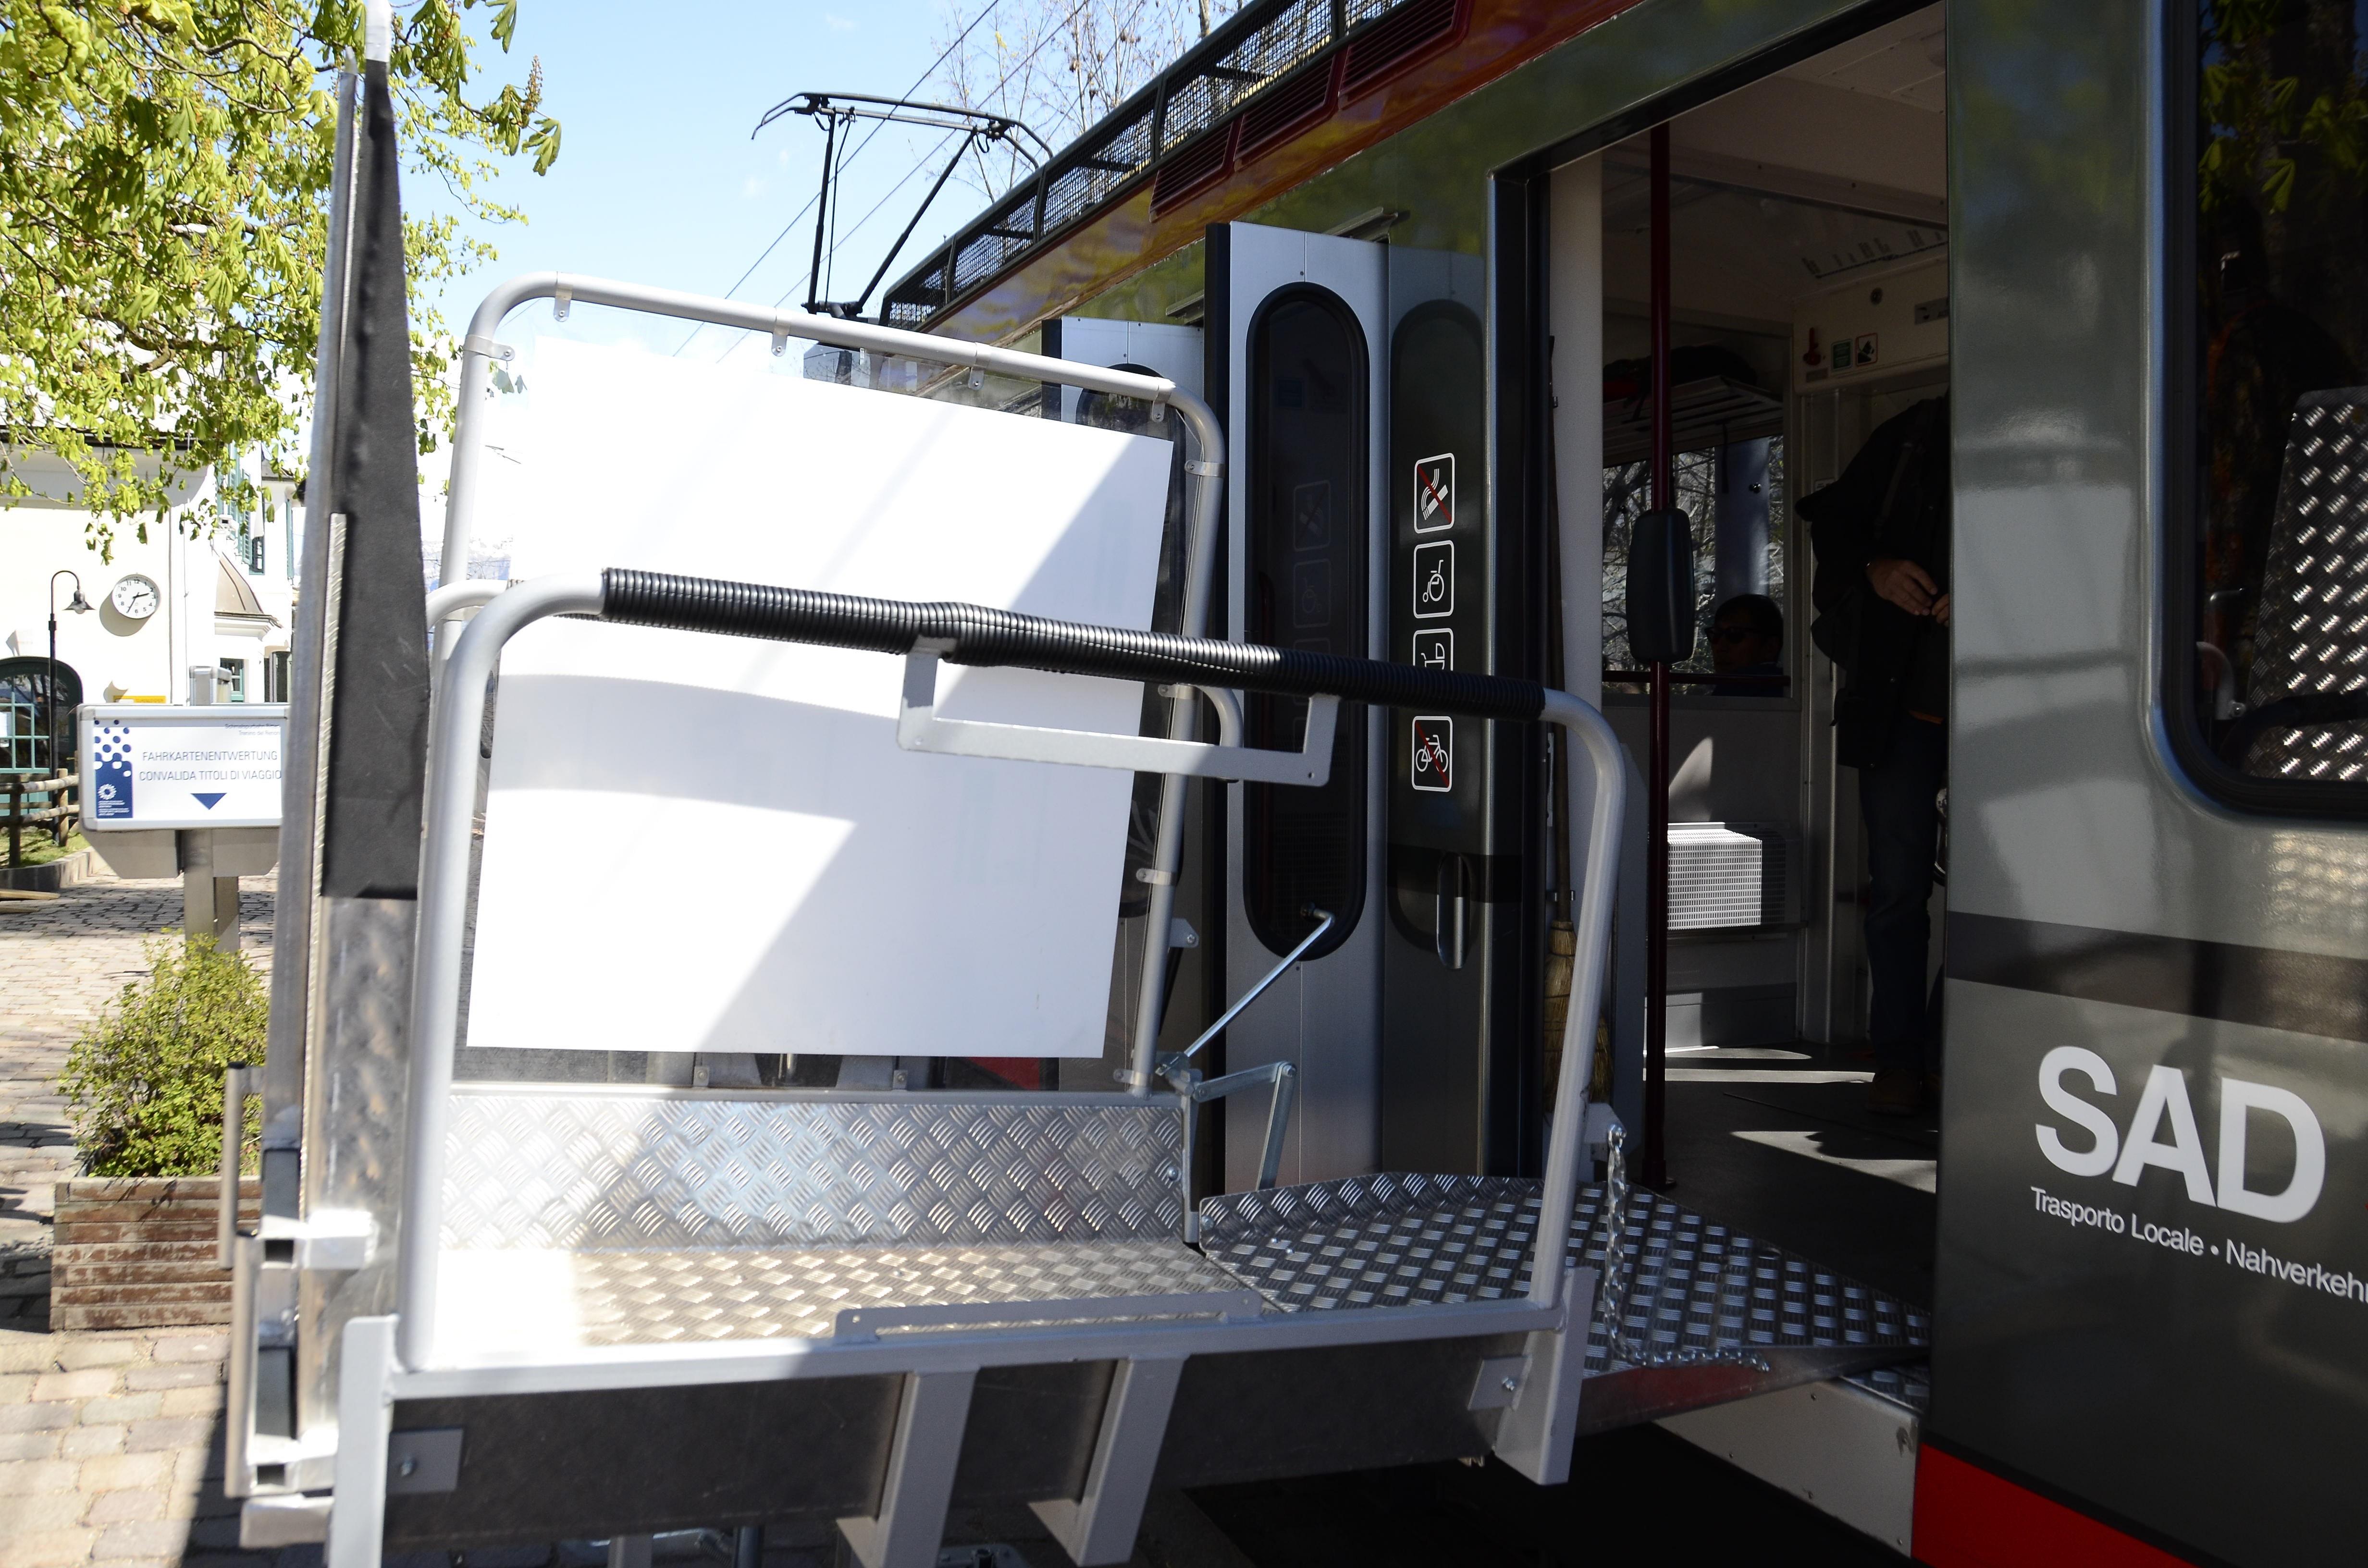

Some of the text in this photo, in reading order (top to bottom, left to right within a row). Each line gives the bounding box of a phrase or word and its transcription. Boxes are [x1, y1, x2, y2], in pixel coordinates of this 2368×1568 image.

[139, 770, 282, 781] CONVALIDA TITOLI DI VIAGGIO
[142, 751, 278, 761] FAHRKARTENENTWERTUNG
[2035, 1046, 2326, 1223] SAD
[2031, 1186, 2125, 1234] Trasporto
[2131, 1214, 2204, 1256] Locale
